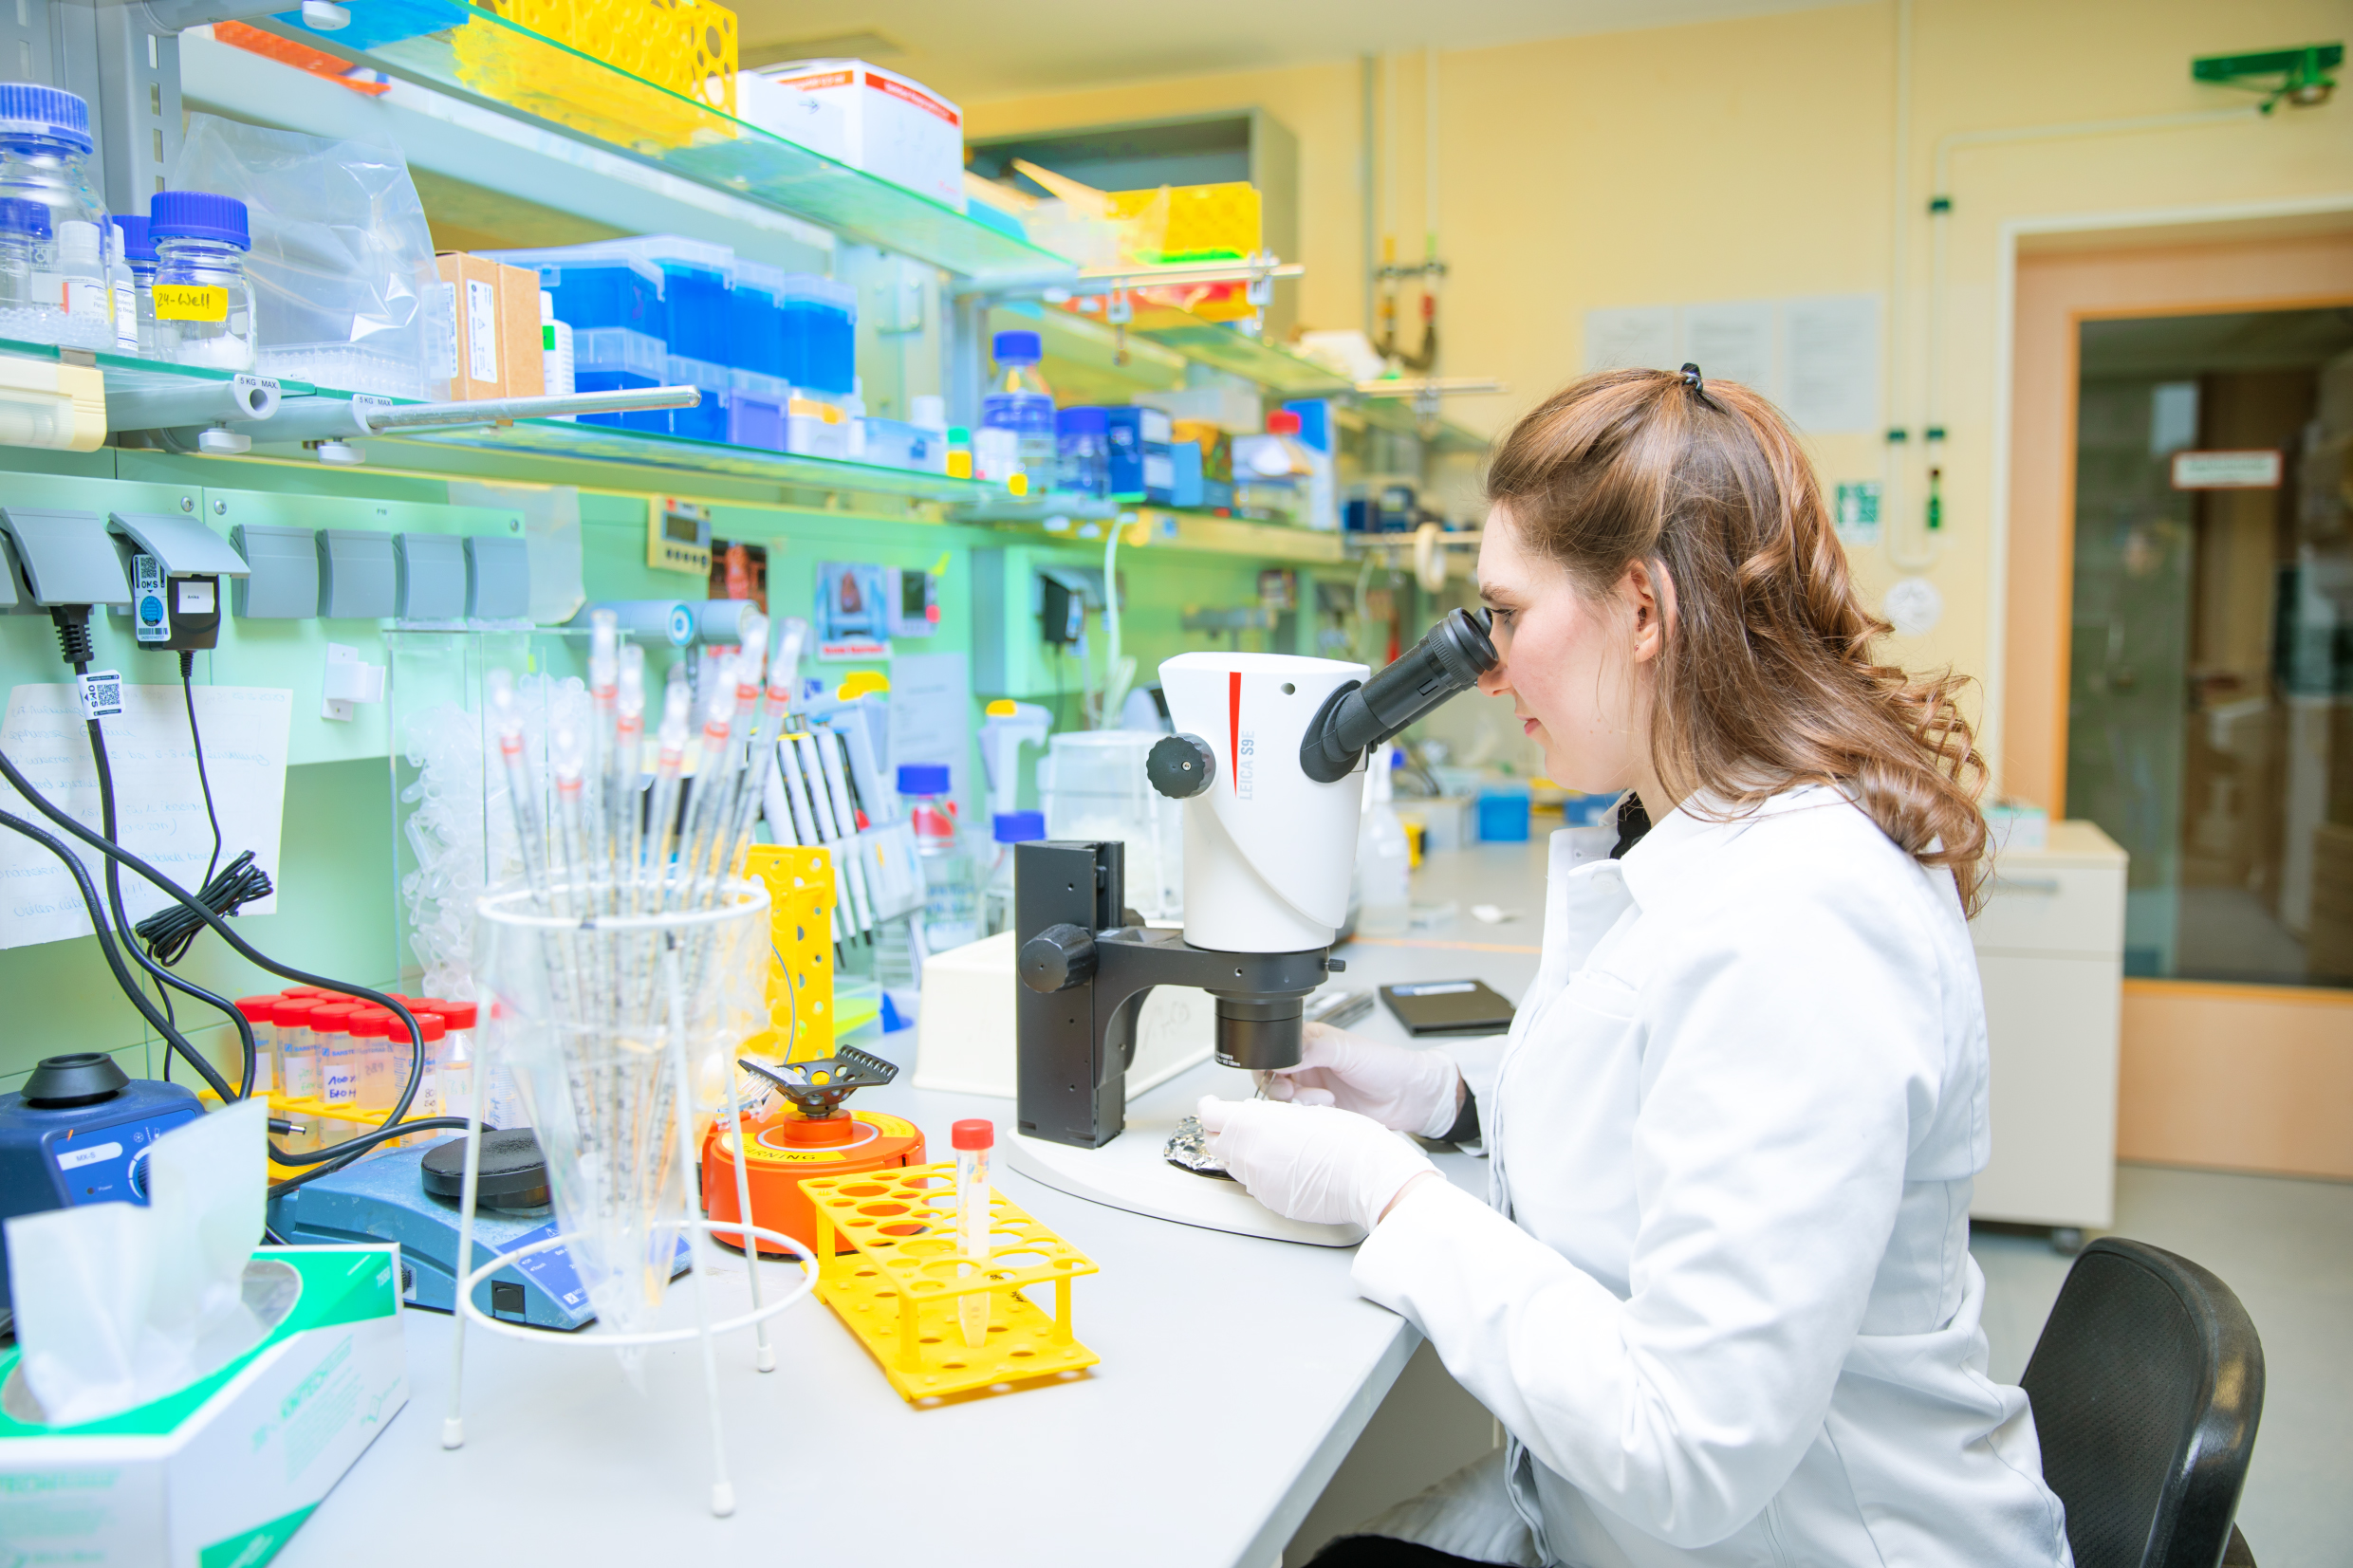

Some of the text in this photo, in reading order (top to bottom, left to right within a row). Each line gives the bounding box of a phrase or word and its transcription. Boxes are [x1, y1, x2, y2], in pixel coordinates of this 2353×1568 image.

[157, 292, 210, 309] 24-Well
[246, 378, 256, 386] KG
[261, 379, 279, 390] MAX.
[87, 685, 98, 708] OMS
[1239, 730, 1255, 802] LEICA S9E
[76, 1152, 96, 1162] MX-S
[741, 1143, 816, 1160] ARNING
